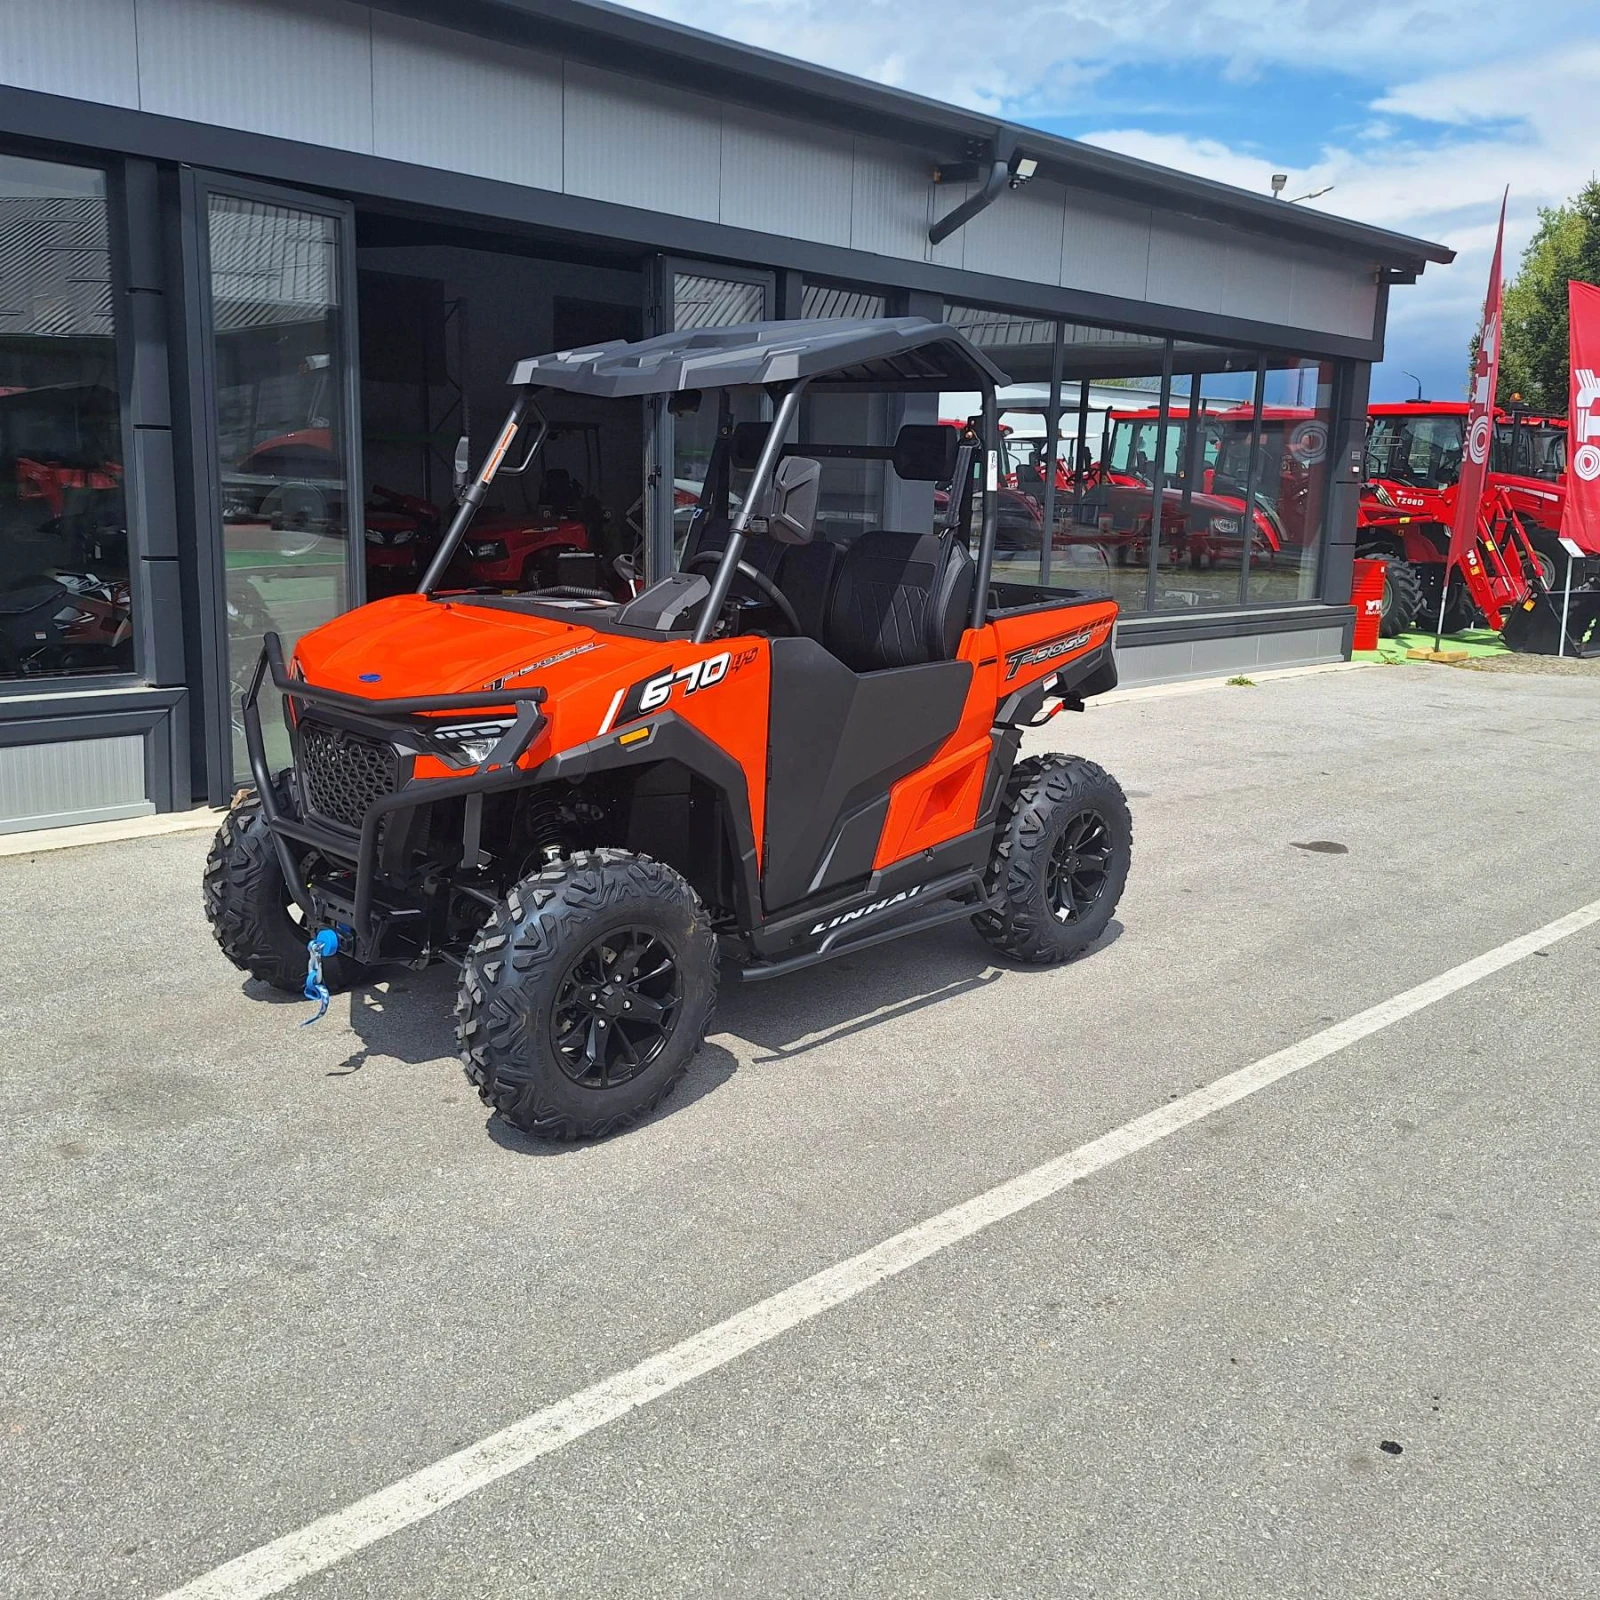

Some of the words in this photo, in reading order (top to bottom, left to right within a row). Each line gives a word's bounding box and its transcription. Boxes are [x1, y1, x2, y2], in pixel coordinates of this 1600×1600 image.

[1005, 630, 1093, 680] T-BOSS
[638, 651, 732, 714] 670
[809, 885, 921, 935] LINHAI
